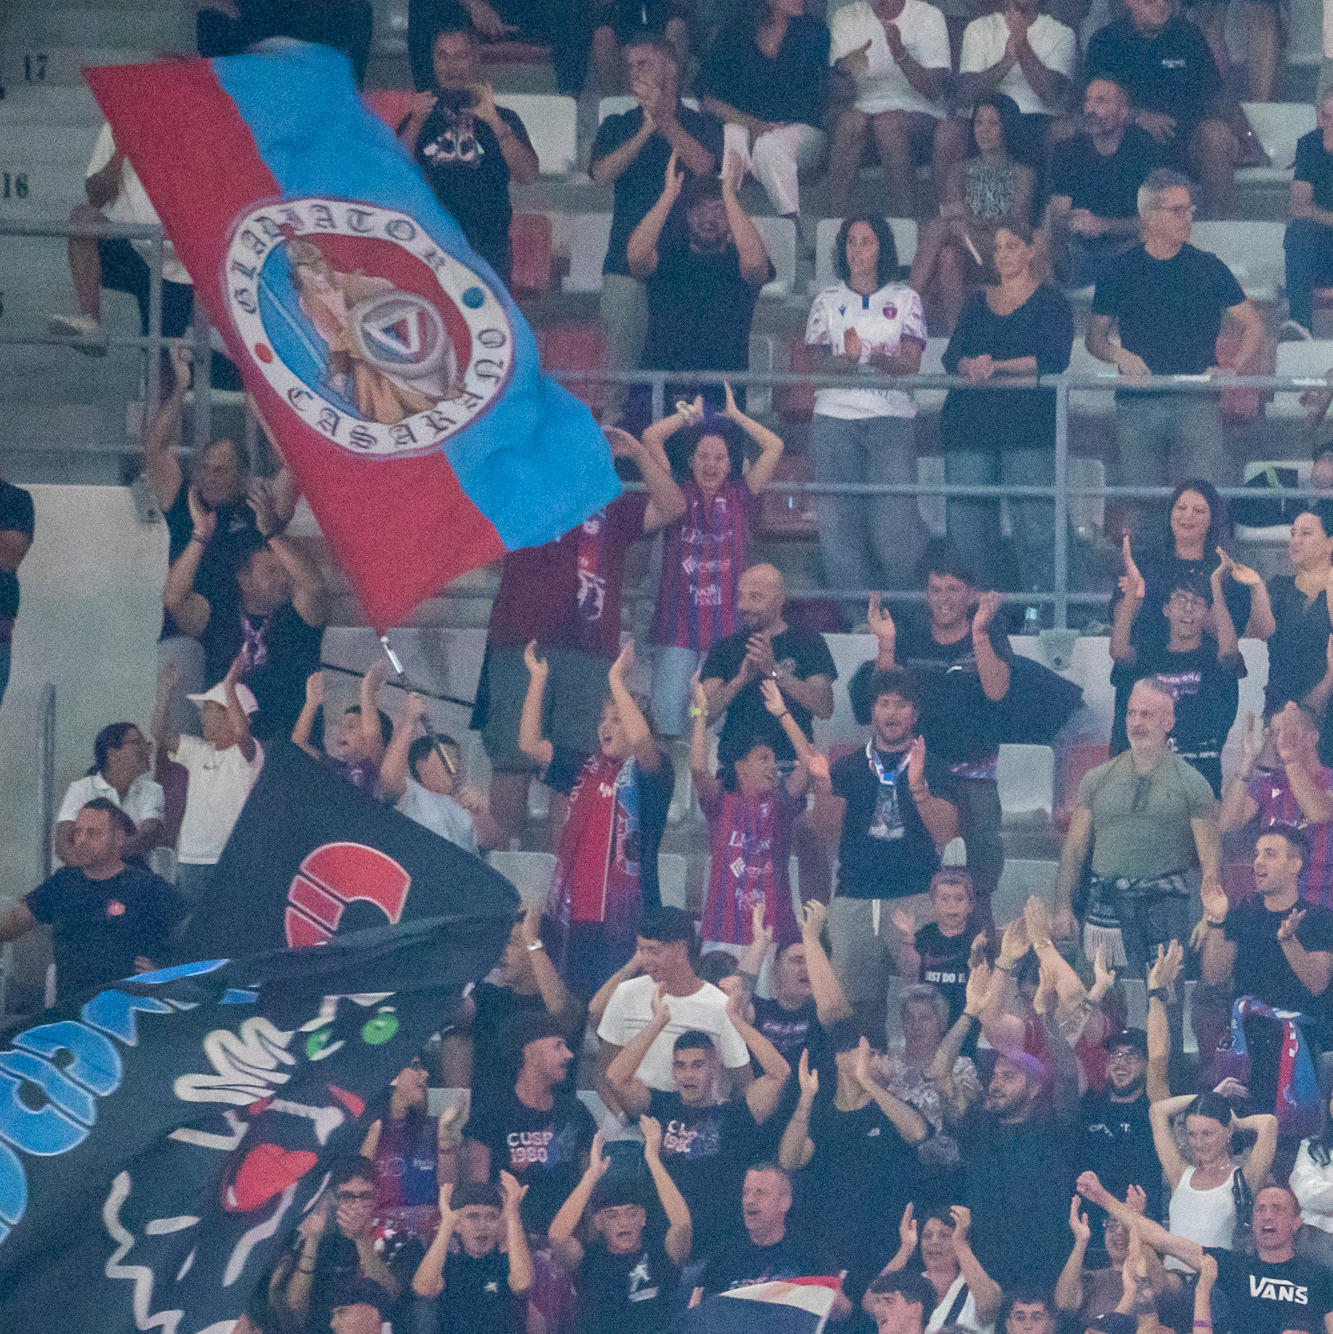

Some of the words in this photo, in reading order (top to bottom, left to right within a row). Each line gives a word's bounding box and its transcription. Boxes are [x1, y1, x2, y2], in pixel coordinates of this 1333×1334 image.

[24, 54, 49, 82] 17
[3, 172, 29, 200] 16
[506, 1131, 554, 1147] CUSP
[1248, 1274, 1309, 1306] VANS
